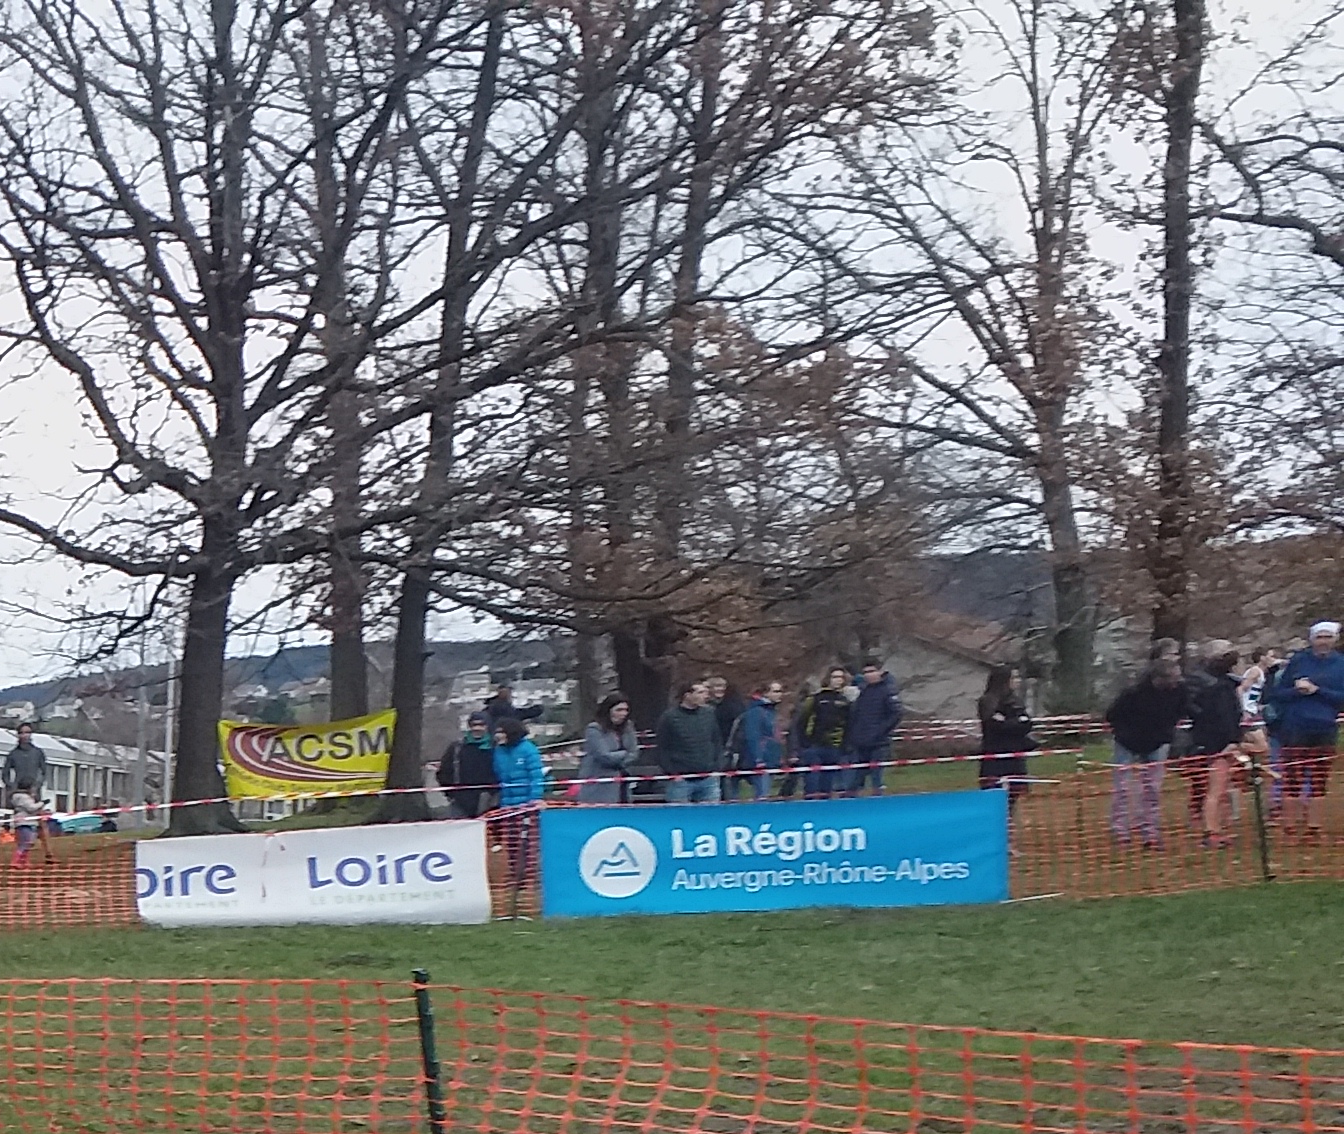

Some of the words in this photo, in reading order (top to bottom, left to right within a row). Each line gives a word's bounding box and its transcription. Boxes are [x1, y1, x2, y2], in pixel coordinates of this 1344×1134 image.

[263, 727, 389, 762] ACSM
[671, 828, 717, 859] La
[725, 822, 867, 861] Région
[307, 851, 453, 888] Loire
[671, 857, 970, 892] Auvergne-Rhône-Alpes
